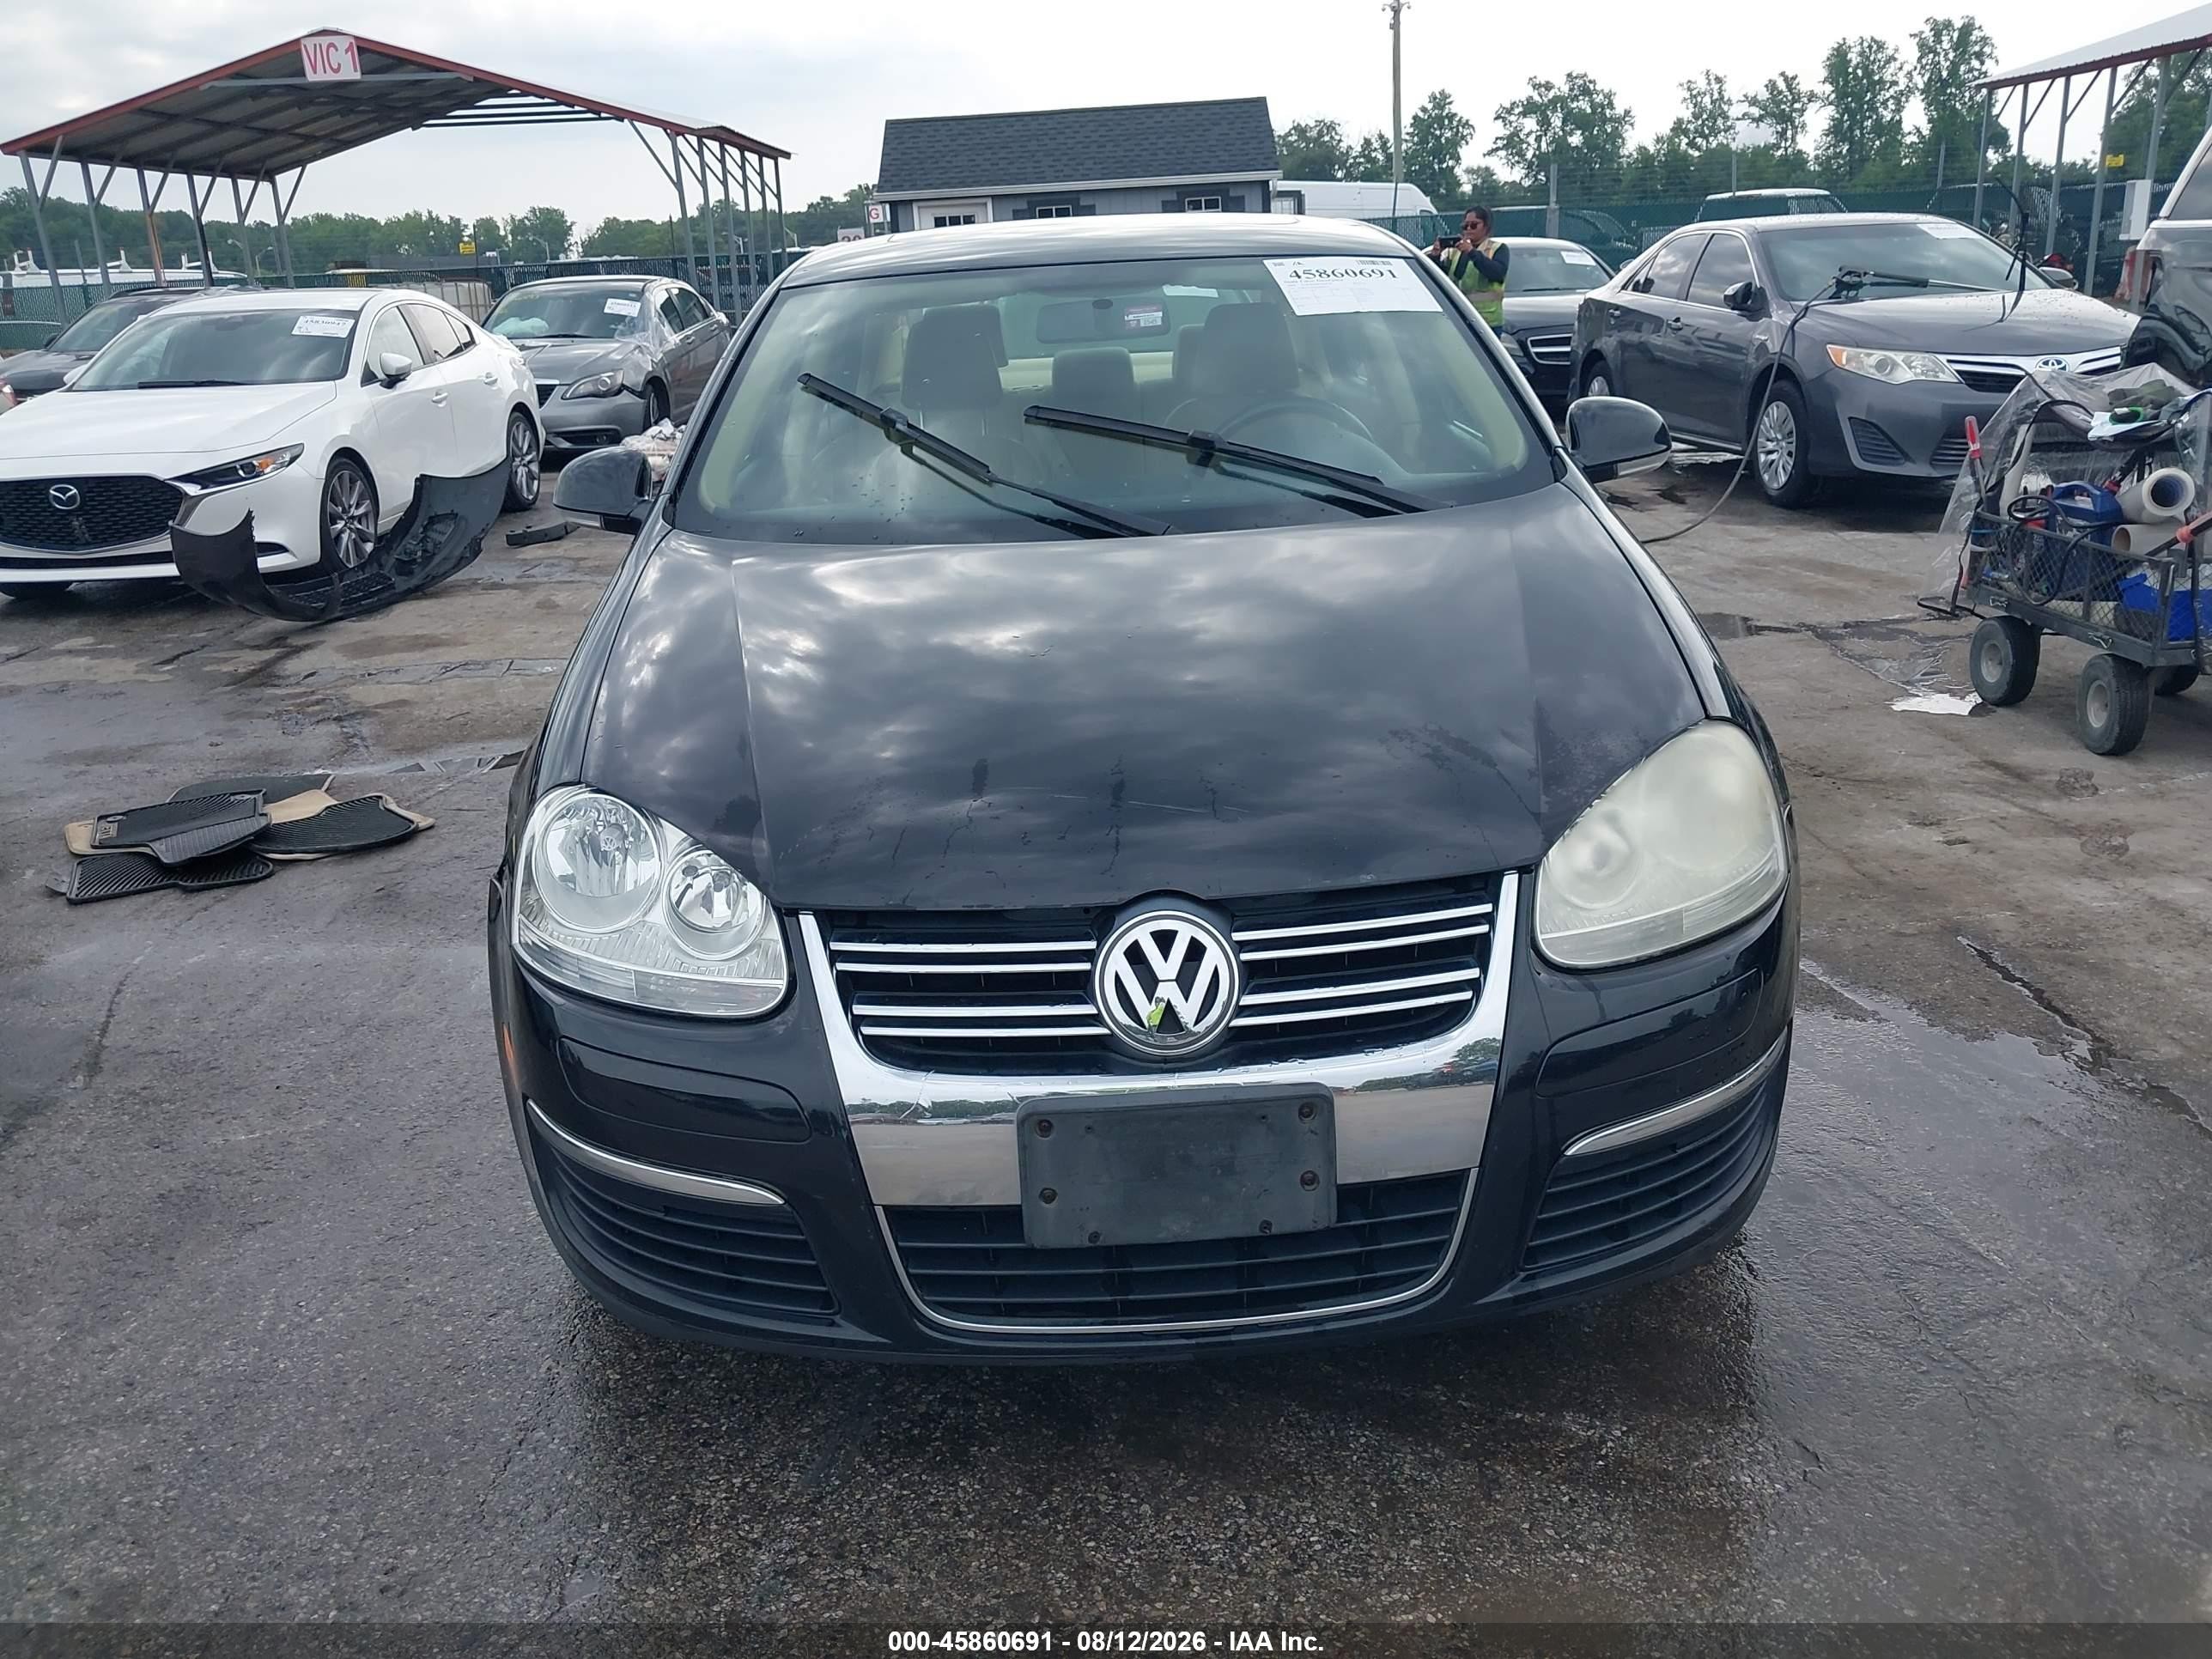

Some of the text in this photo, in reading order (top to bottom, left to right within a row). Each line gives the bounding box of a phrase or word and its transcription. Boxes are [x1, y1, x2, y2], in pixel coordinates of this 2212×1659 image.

[303, 41, 358, 75] VIC 1
[869, 208, 879, 219] G
[1289, 268, 1399, 279] 45860691
[1103, 919, 1231, 1047] VW
